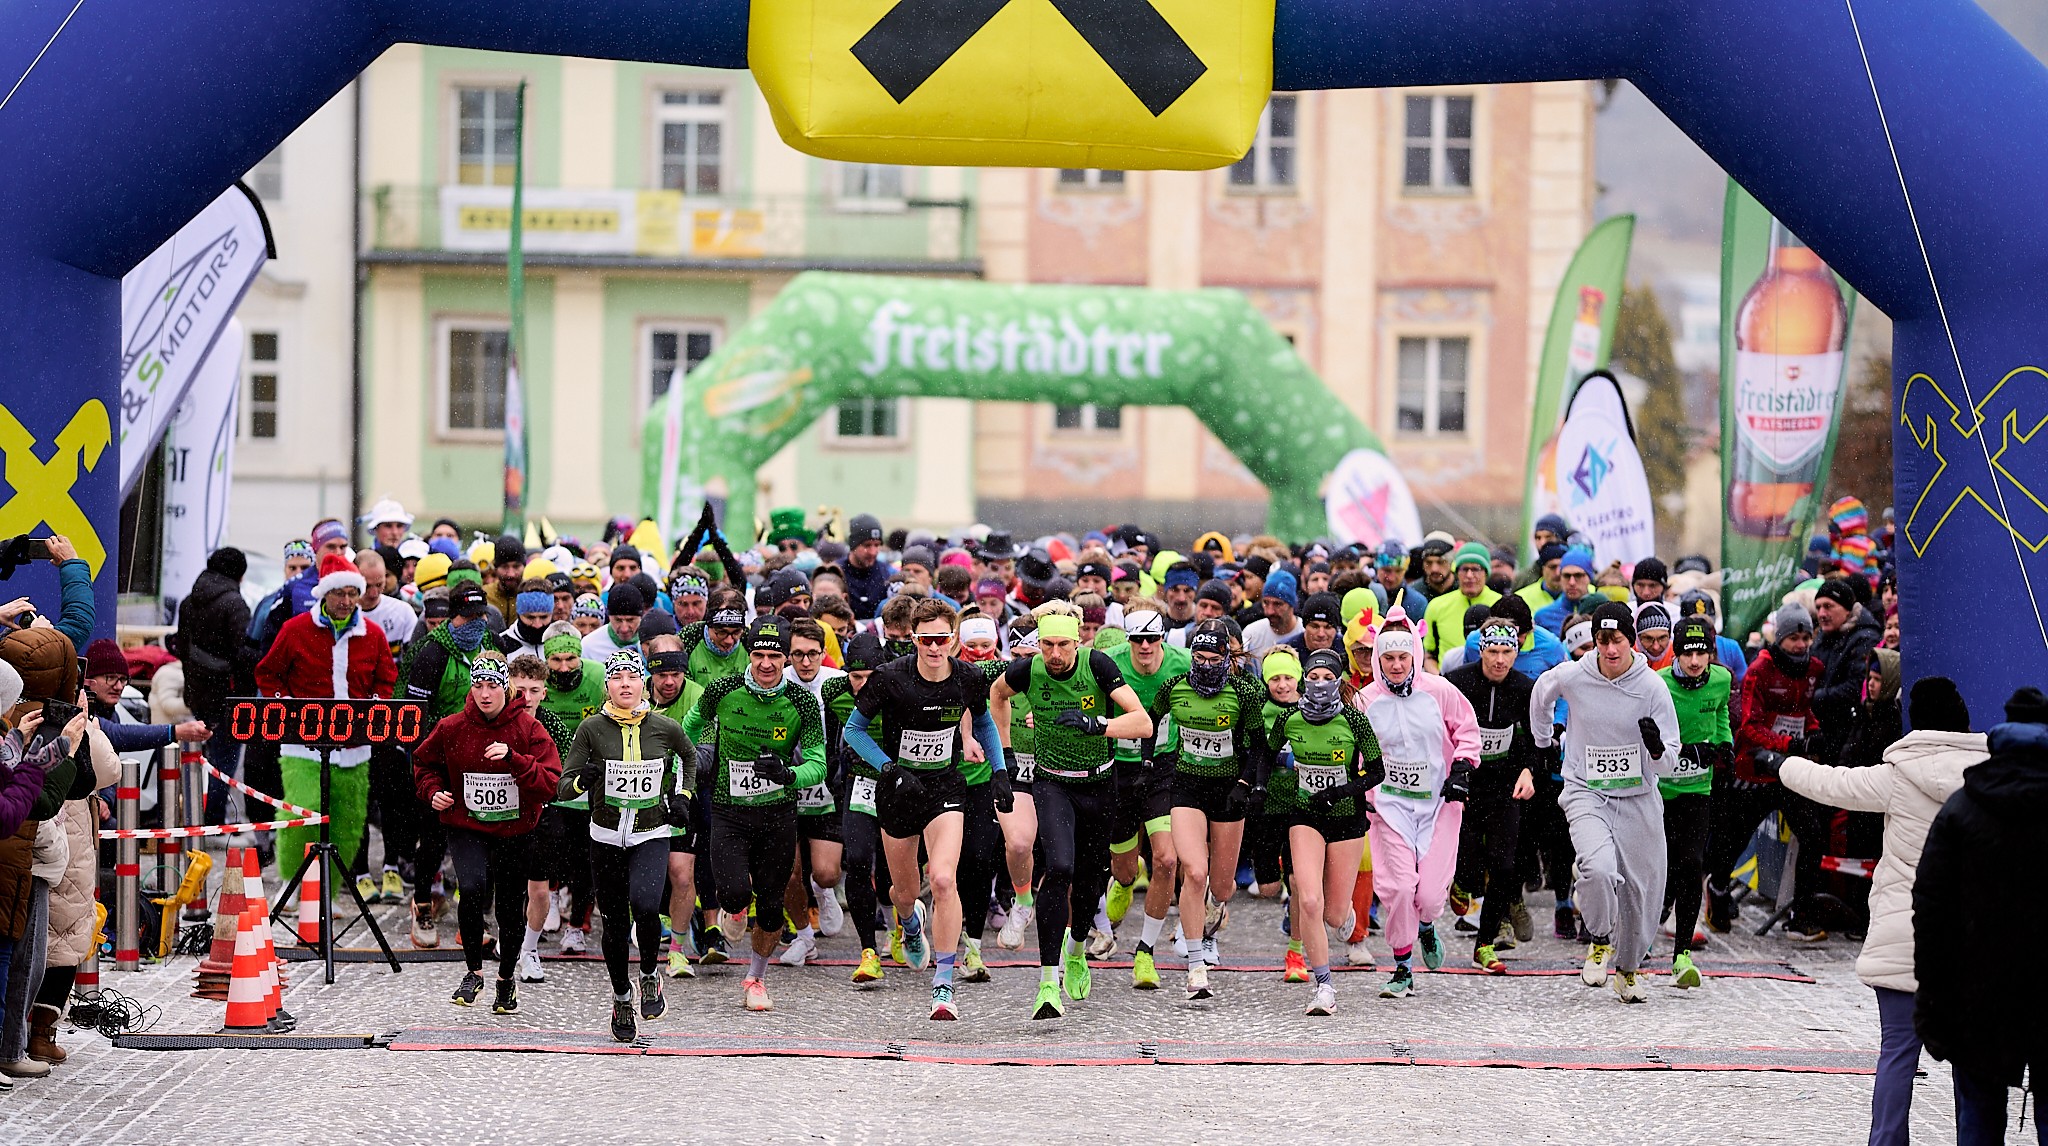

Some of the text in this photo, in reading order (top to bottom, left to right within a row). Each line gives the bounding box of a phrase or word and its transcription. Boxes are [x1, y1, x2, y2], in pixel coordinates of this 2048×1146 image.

[861, 299, 1173, 378] freistädter
[231, 702, 422, 743] 00:00:00
[724, 725, 744, 735] Region
[742, 725, 772, 734] Raiffeisen
[909, 744, 944, 757] 478
[1588, 750, 1638, 758] Silvesterlauf
[608, 767, 661, 775] Silvesterlauf
[1597, 758, 1630, 774] 533
[466, 780, 516, 788] Silvesterlauf
[1306, 775, 1336, 789] 480
[1389, 770, 1420, 786] 532
[616, 777, 652, 793] 216
[473, 789, 507, 805] 508
[746, 788, 769, 796] HANNES
